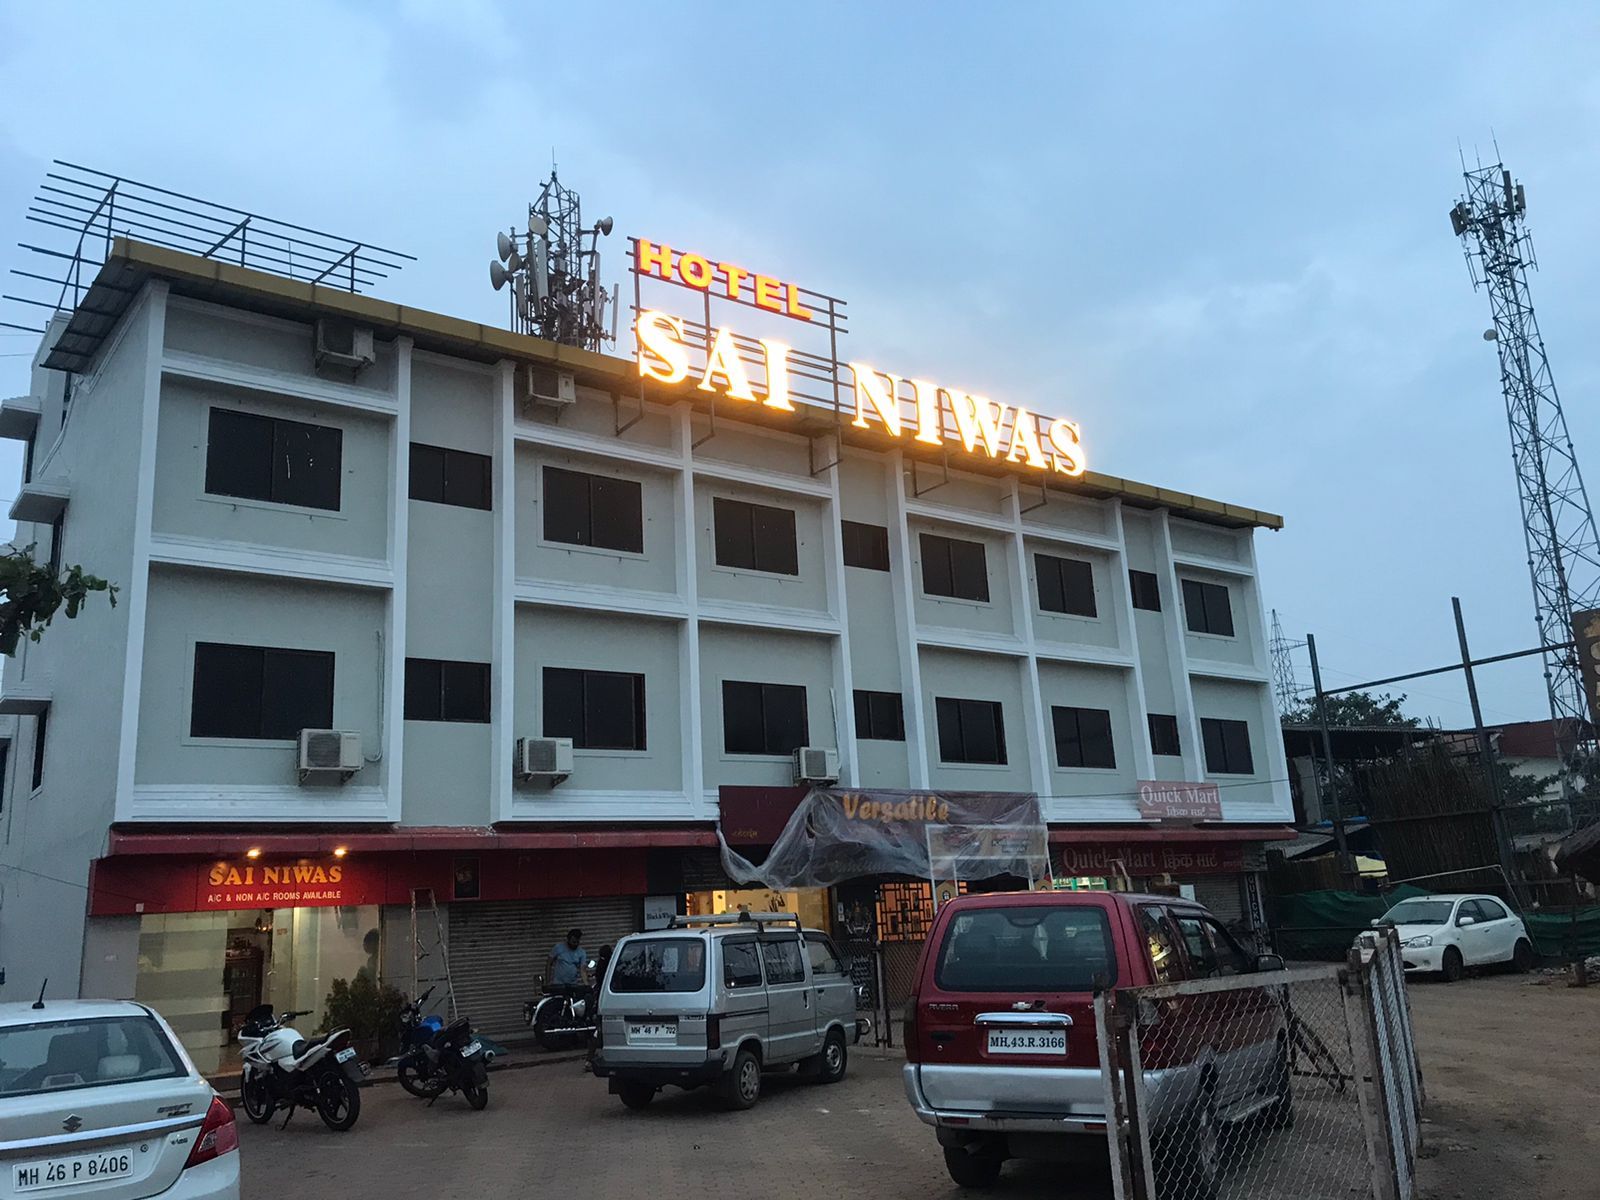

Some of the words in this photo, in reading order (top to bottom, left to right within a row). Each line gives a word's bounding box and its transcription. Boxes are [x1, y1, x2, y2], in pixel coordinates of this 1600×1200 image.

[636, 238, 813, 320] HOTEL
[636, 309, 796, 412] SAI
[848, 361, 1087, 478] NIWAS
[842, 793, 949, 824] Versatile
[1141, 785, 1182, 806] Quick
[1184, 787, 1219, 804] Mart
[209, 861, 254, 886] SAI
[262, 865, 342, 884] NIWAS
[1063, 847, 1114, 874] Quick
[207, 894, 222, 903] A/C
[226, 894, 231, 902] &
[235, 893, 254, 902] NON
[256, 892, 270, 901] A/C
[272, 891, 301, 901] ROOMS
[302, 890, 341, 900] AVAILABLE
[18, 1169, 39, 1187] MH
[46, 1164, 66, 1181] 46
[73, 1162, 82, 1179] P
[88, 1156, 128, 1176] 8406
